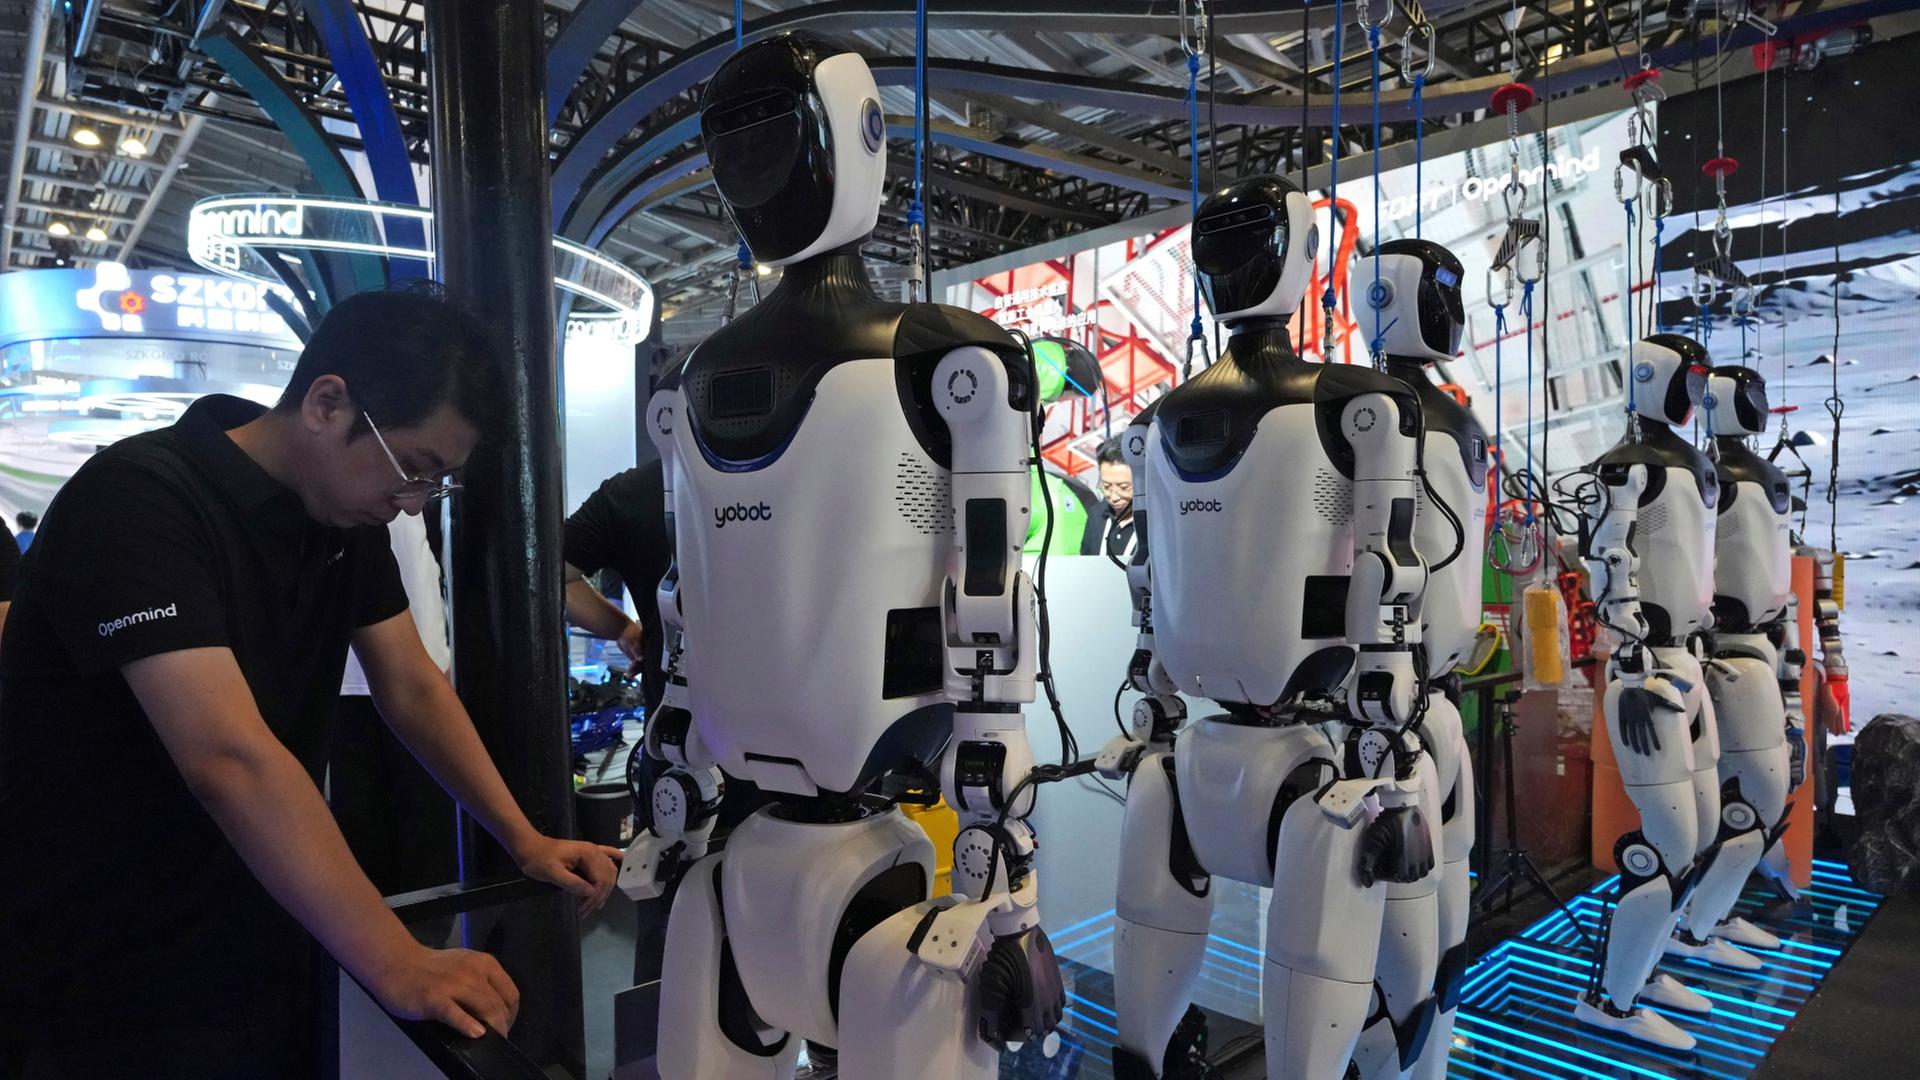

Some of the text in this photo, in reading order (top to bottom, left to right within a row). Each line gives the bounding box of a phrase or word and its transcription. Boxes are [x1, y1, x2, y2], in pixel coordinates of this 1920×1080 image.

[1462, 146, 1600, 201] Openmind
[714, 501, 772, 528] yobot
[1180, 498, 1222, 516] yobot
[98, 603, 177, 637] Openmind
